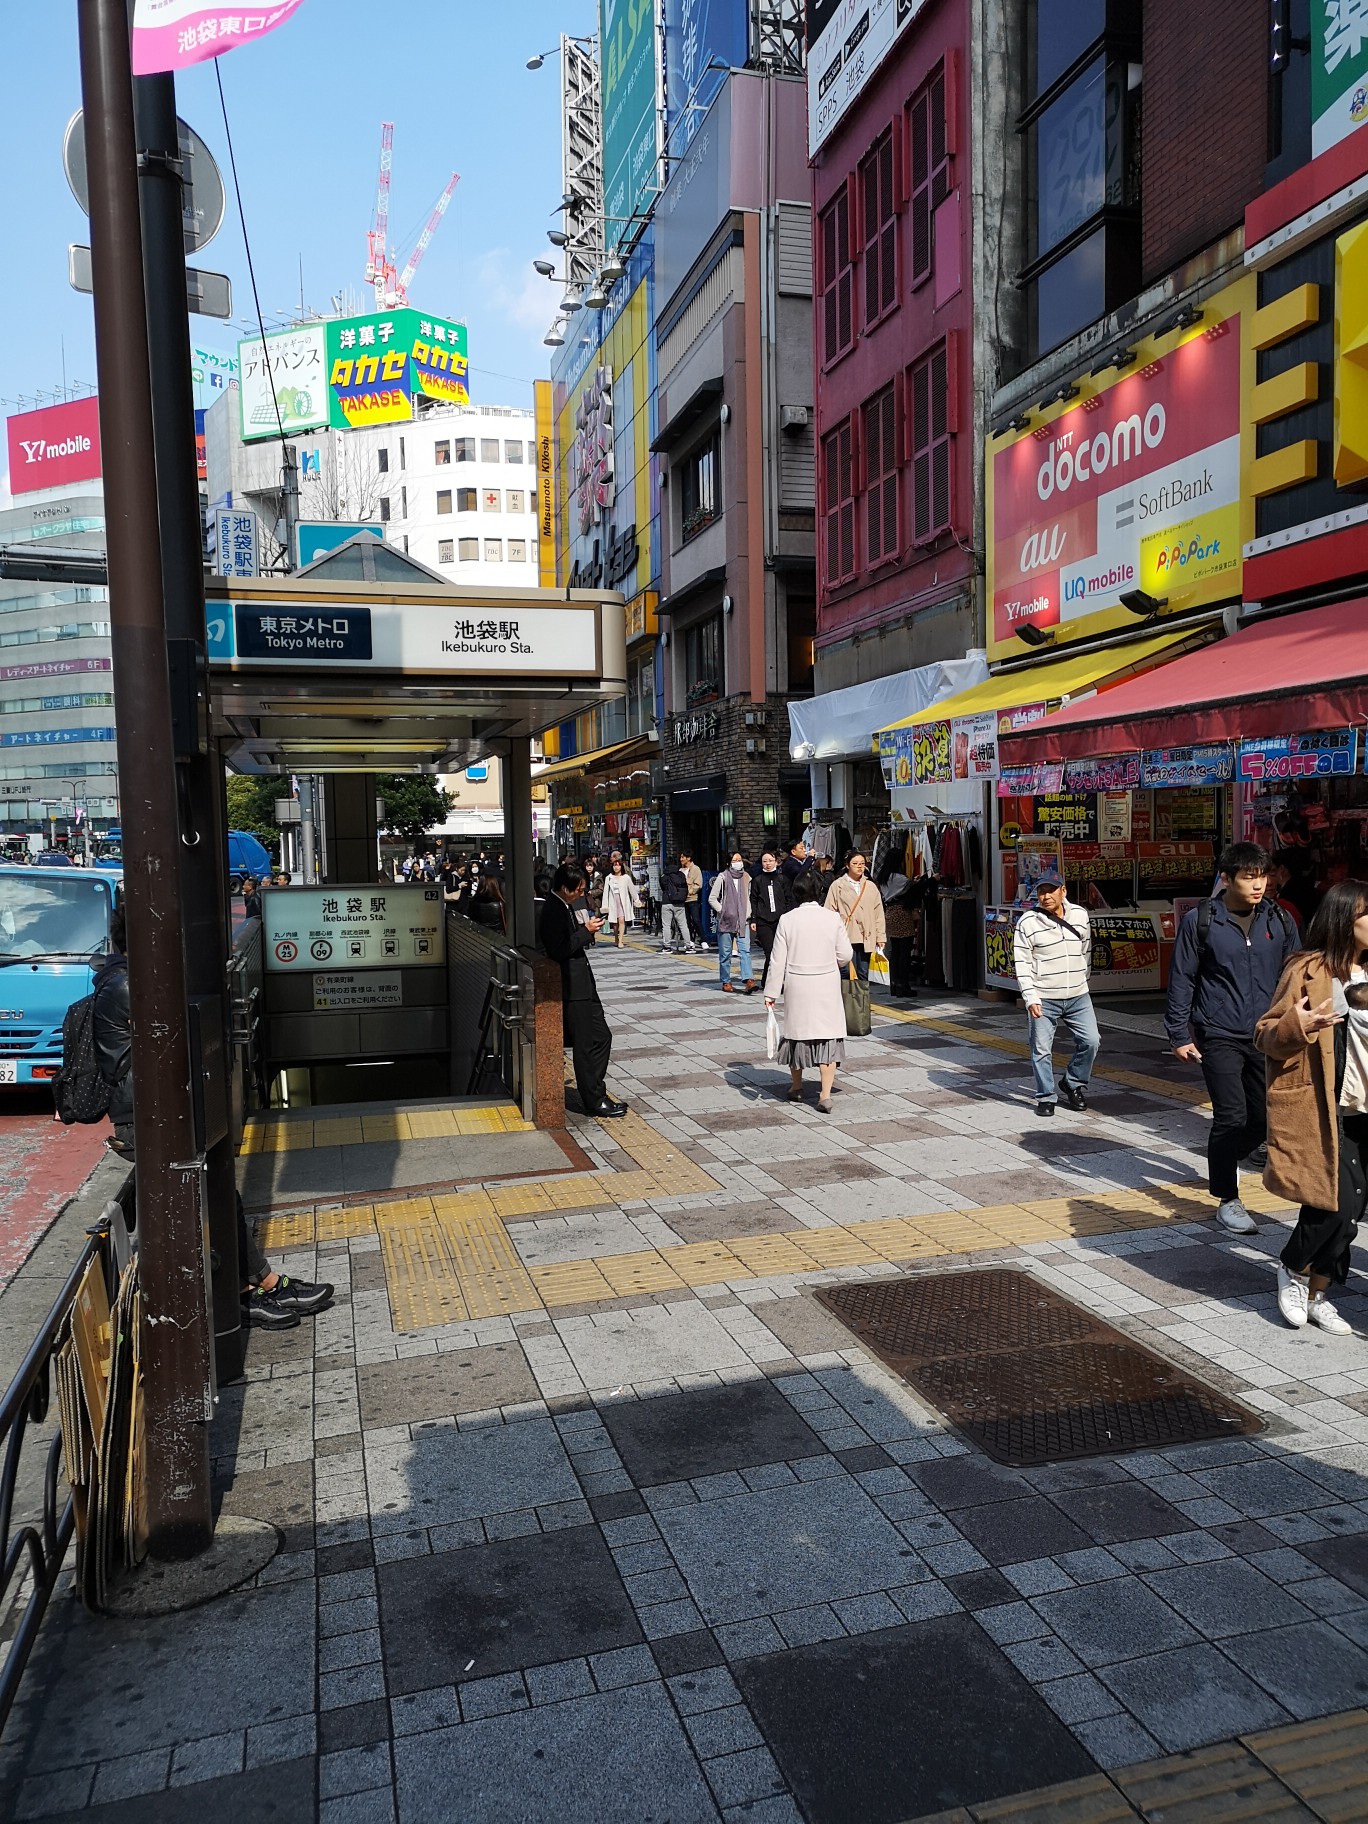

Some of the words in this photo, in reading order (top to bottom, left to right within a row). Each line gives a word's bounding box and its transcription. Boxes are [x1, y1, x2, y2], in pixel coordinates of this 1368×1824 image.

[340, 321, 395, 350] 洋菓子
[419, 319, 459, 346] 洋菓子
[244, 347, 321, 380] アドバンス
[330, 349, 408, 387] タカセ
[411, 339, 469, 377] タカセ
[417, 370, 464, 396] TAKASE
[338, 388, 401, 414] TAKASE
[1037, 402, 1167, 501] docomo
[1056, 430, 1073, 453] NTT
[541, 435, 550, 474] KiYoshi
[1138, 468, 1214, 520] SoftBank
[542, 477, 552, 537] Matsumoto
[221, 516, 231, 560] Ikebukuro
[1020, 523, 1067, 573] au
[1064, 575, 1086, 602] UQ
[1088, 563, 1134, 593] mobile
[258, 616, 349, 635] 東京メトロ
[454, 619, 521, 641] 池袋駅
[265, 635, 304, 650] Tokyo
[306, 636, 344, 649] Metro
[441, 640, 507, 654] Ikebukuro
[510, 641, 534, 654] Sta.
[11, 731, 79, 745] アートネイチャー
[90, 729, 104, 739] 4F
[969, 742, 995, 761] 超特価
[1037, 805, 1096, 822] 驚安価格で
[1044, 821, 1090, 839] 販売中
[1159, 843, 1197, 856] au
[322, 897, 387, 914] 池袋駅
[426, 891, 437, 900] 42
[323, 914, 367, 922] Ikebukuro
[369, 913, 386, 921] Sta.
[1089, 918, 1152, 930] 3月はスマホが
[274, 931, 298, 939] 丸ノ内線
[1091, 928, 1154, 939] 1年で一番安い
[281, 950, 292, 958] 25
[316, 949, 327, 957] 09
